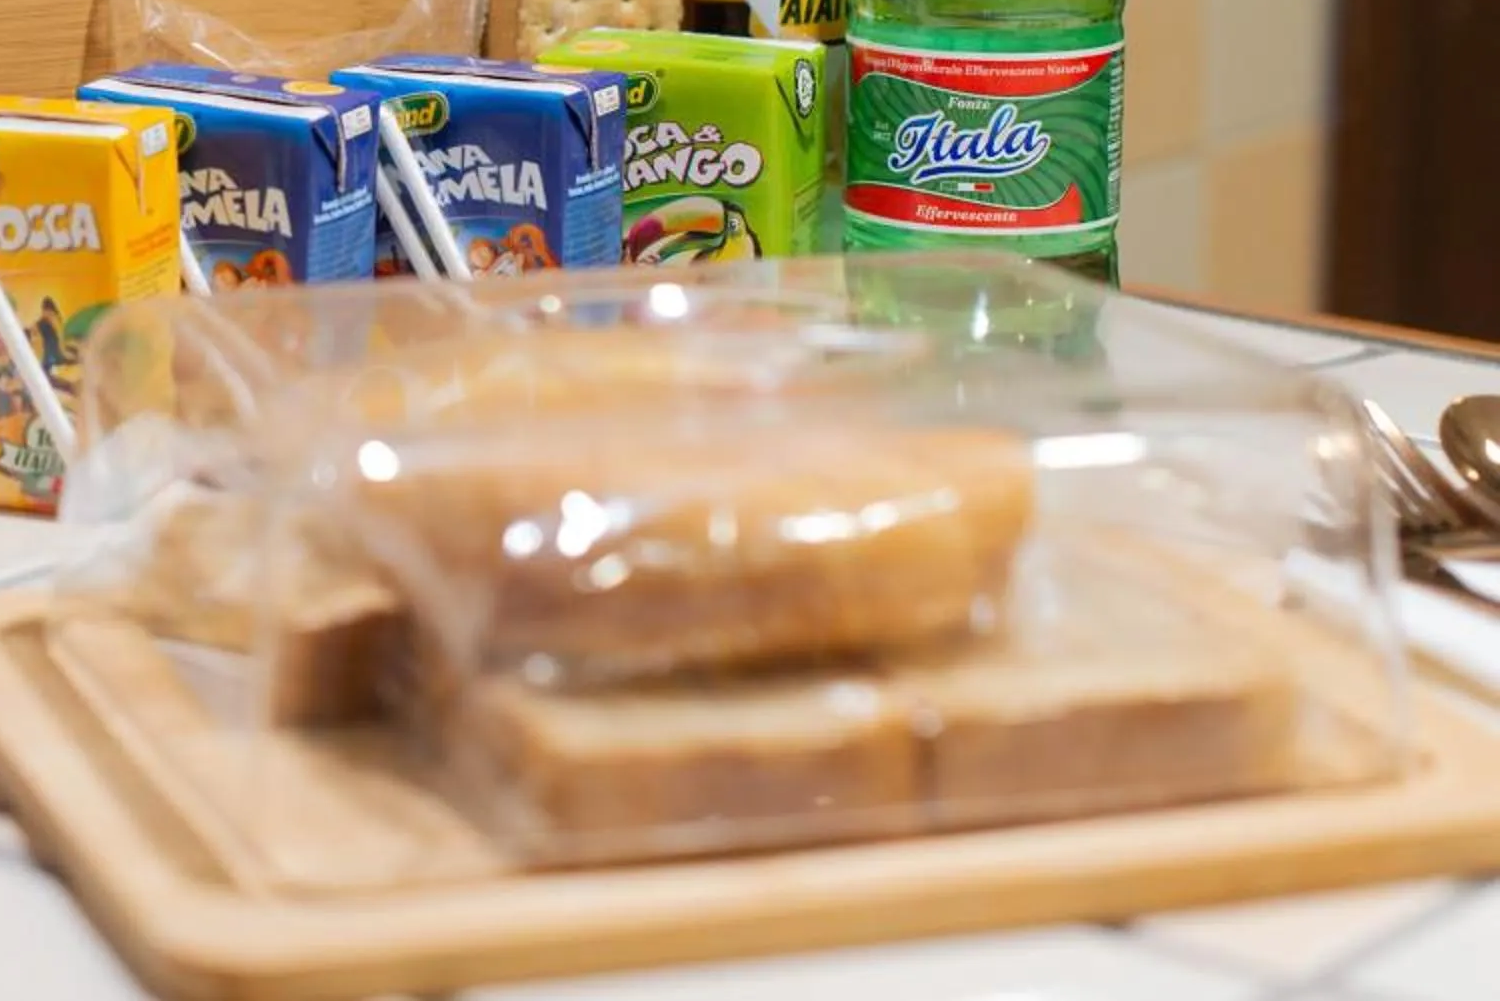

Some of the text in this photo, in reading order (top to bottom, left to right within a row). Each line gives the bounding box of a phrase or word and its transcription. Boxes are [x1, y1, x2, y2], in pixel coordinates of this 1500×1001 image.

[623, 142, 763, 192] ANGO
[888, 103, 1050, 183] Itala
[915, 204, 1019, 223] Effervescente
